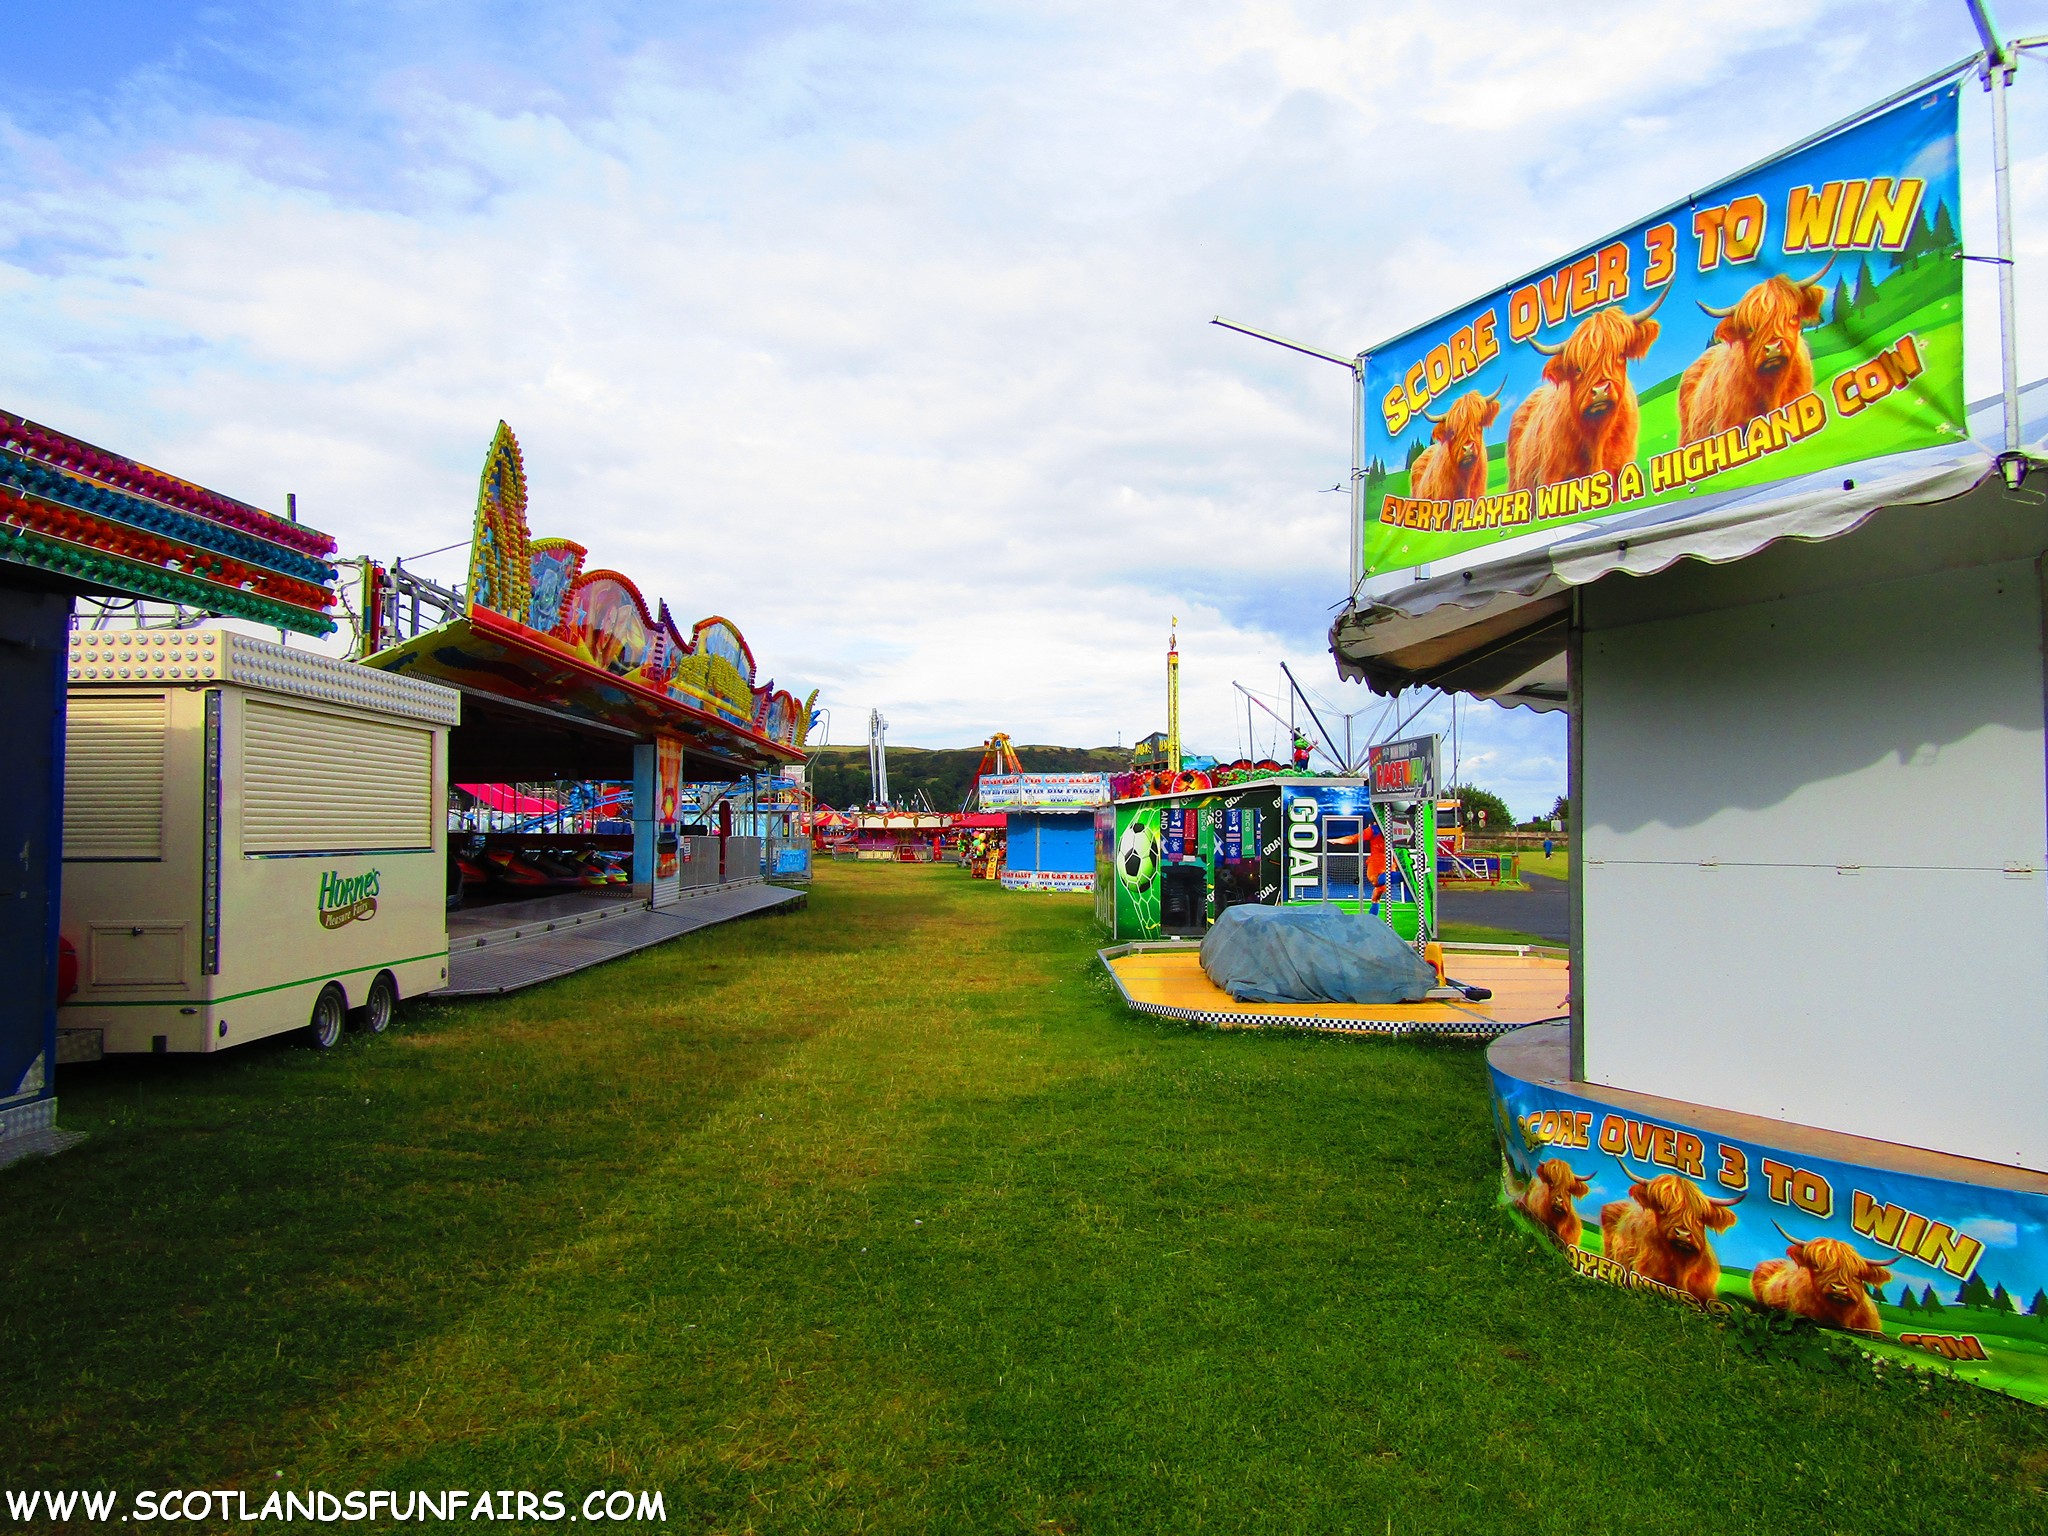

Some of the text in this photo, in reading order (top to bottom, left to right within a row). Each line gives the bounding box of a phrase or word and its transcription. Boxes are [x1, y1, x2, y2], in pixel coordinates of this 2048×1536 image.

[1381, 177, 1926, 434] SCORE OVER 3 TO WIN
[1379, 332, 1926, 533] EVERY PLAYER WINS A HIGHLAND COW
[1287, 797, 1319, 900] GOAL
[1517, 1110, 1987, 1283] SCORE OVER 3 TO WIN
